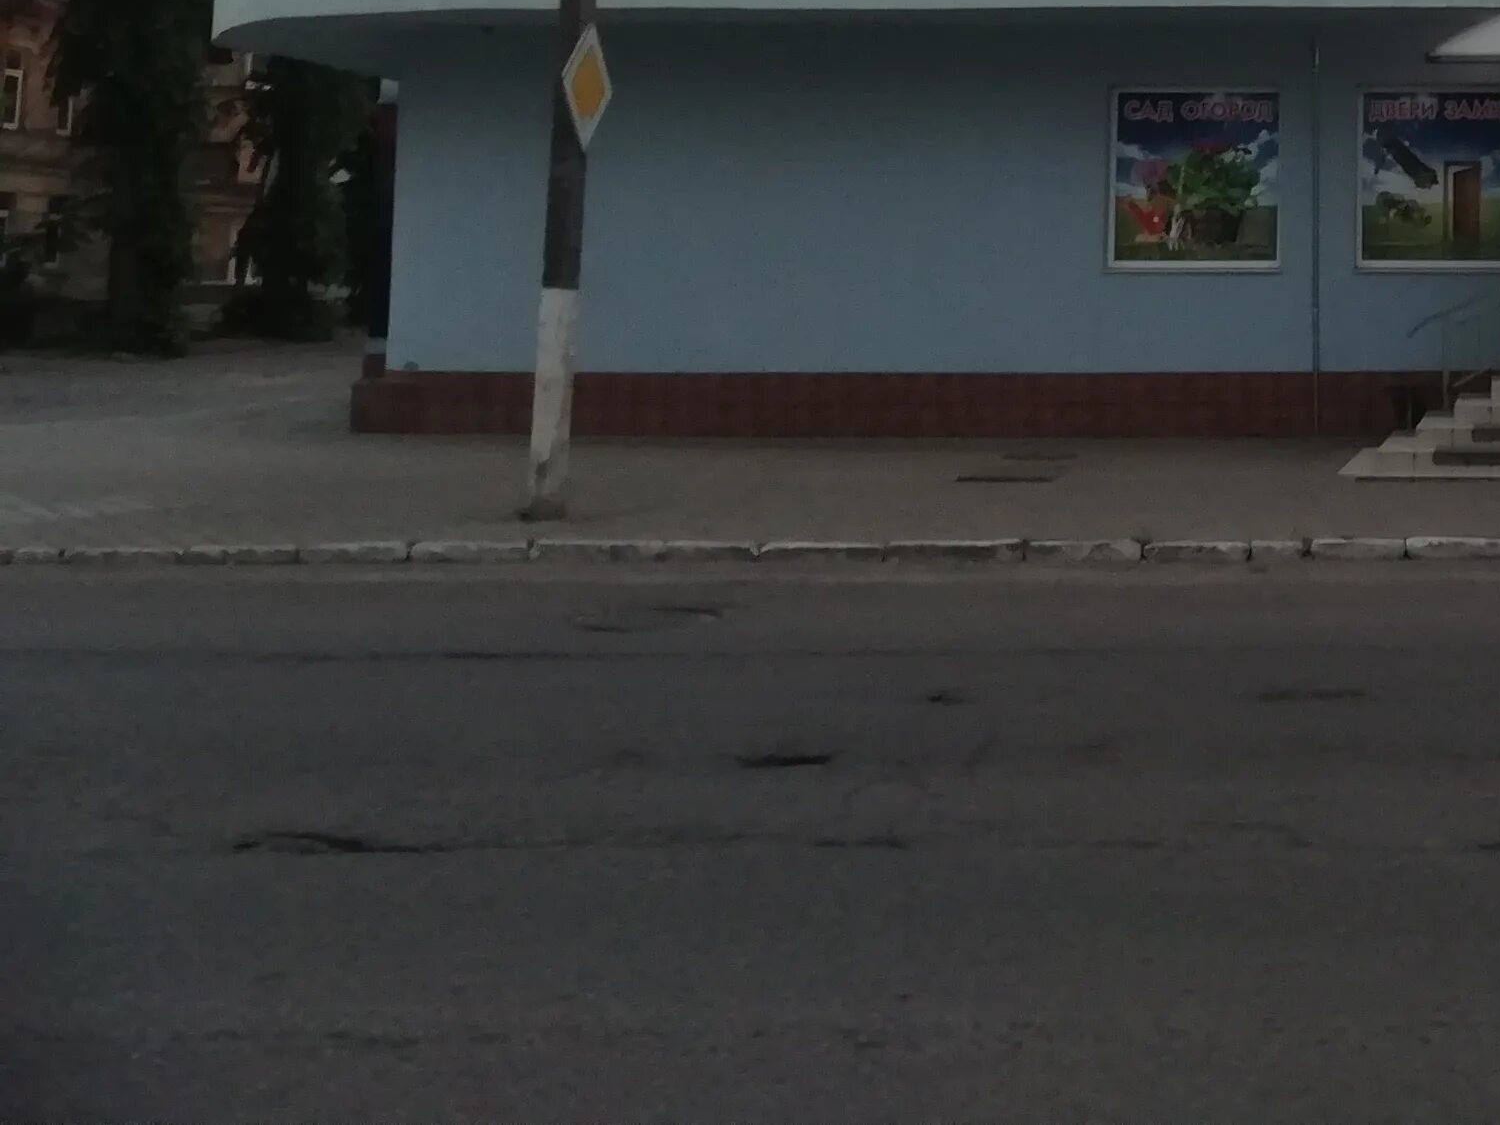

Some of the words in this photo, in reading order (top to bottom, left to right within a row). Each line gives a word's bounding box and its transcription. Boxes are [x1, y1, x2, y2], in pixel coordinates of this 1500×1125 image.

[1124, 99, 1174, 123] САД
[1180, 98, 1274, 123] ОГОРОД
[1369, 98, 1439, 122] ДВЕРИ
